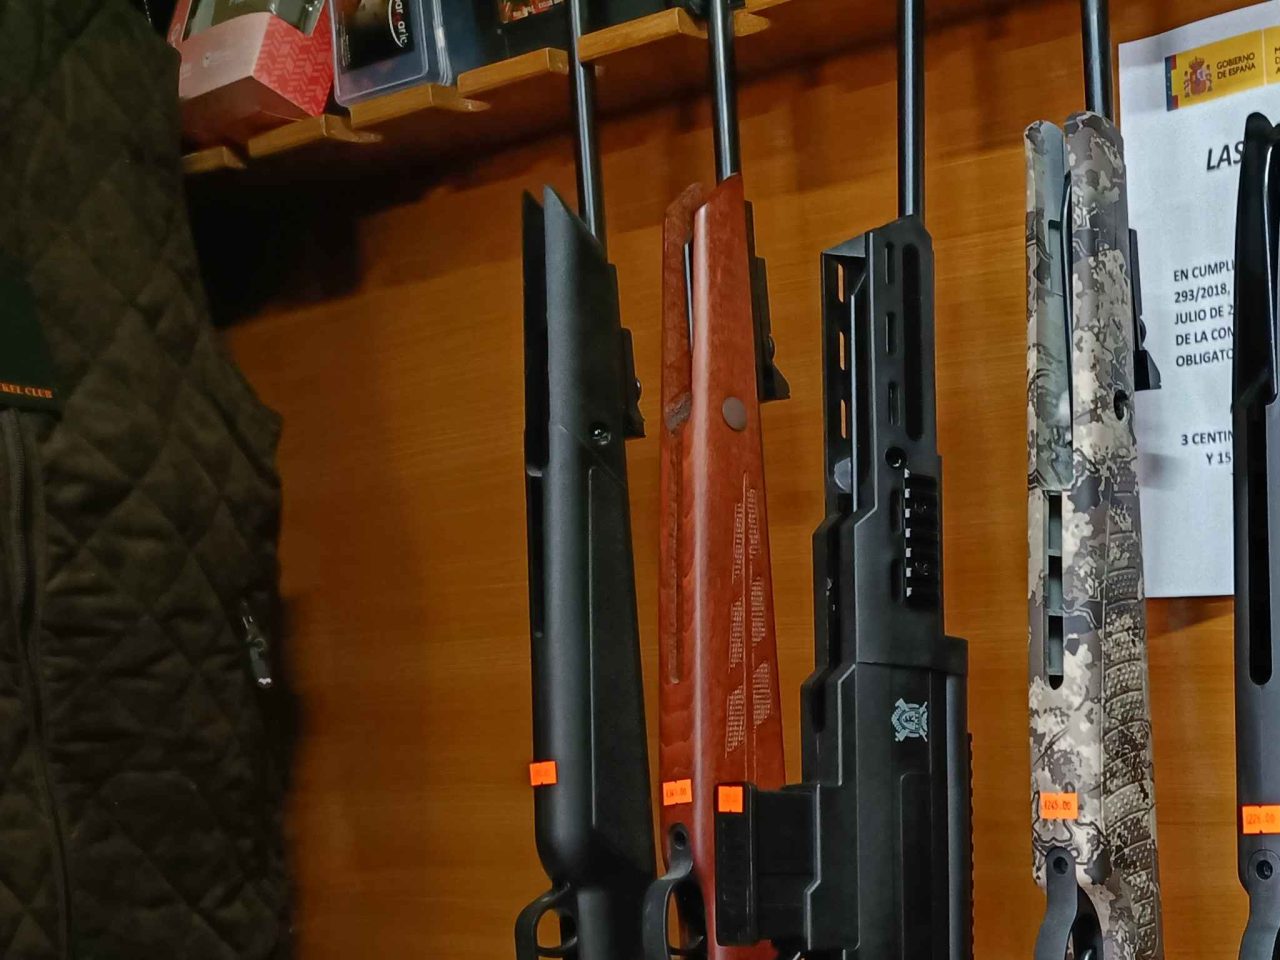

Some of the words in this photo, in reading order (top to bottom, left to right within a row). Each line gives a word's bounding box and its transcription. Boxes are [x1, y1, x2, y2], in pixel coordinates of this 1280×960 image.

[1217, 52, 1255, 69] GOBIERNO
[1217, 71, 1227, 79] DE
[1228, 61, 1256, 76] ESPAÑA
[1206, 140, 1243, 171] LAS
[1173, 269, 1189, 282] EN
[1192, 259, 1235, 278] CUMPLI
[1174, 283, 1231, 303] 293/2018,
[1174, 309, 1207, 325] JULIO
[1210, 305, 1224, 319] DE
[1175, 333, 1191, 346] DE
[1194, 330, 1209, 344] LA
[1175, 348, 1233, 367] OBLIGATO
[1181, 433, 1188, 446] 3
[1206, 452, 1213, 466] Y
[1218, 451, 1232, 465] 15
